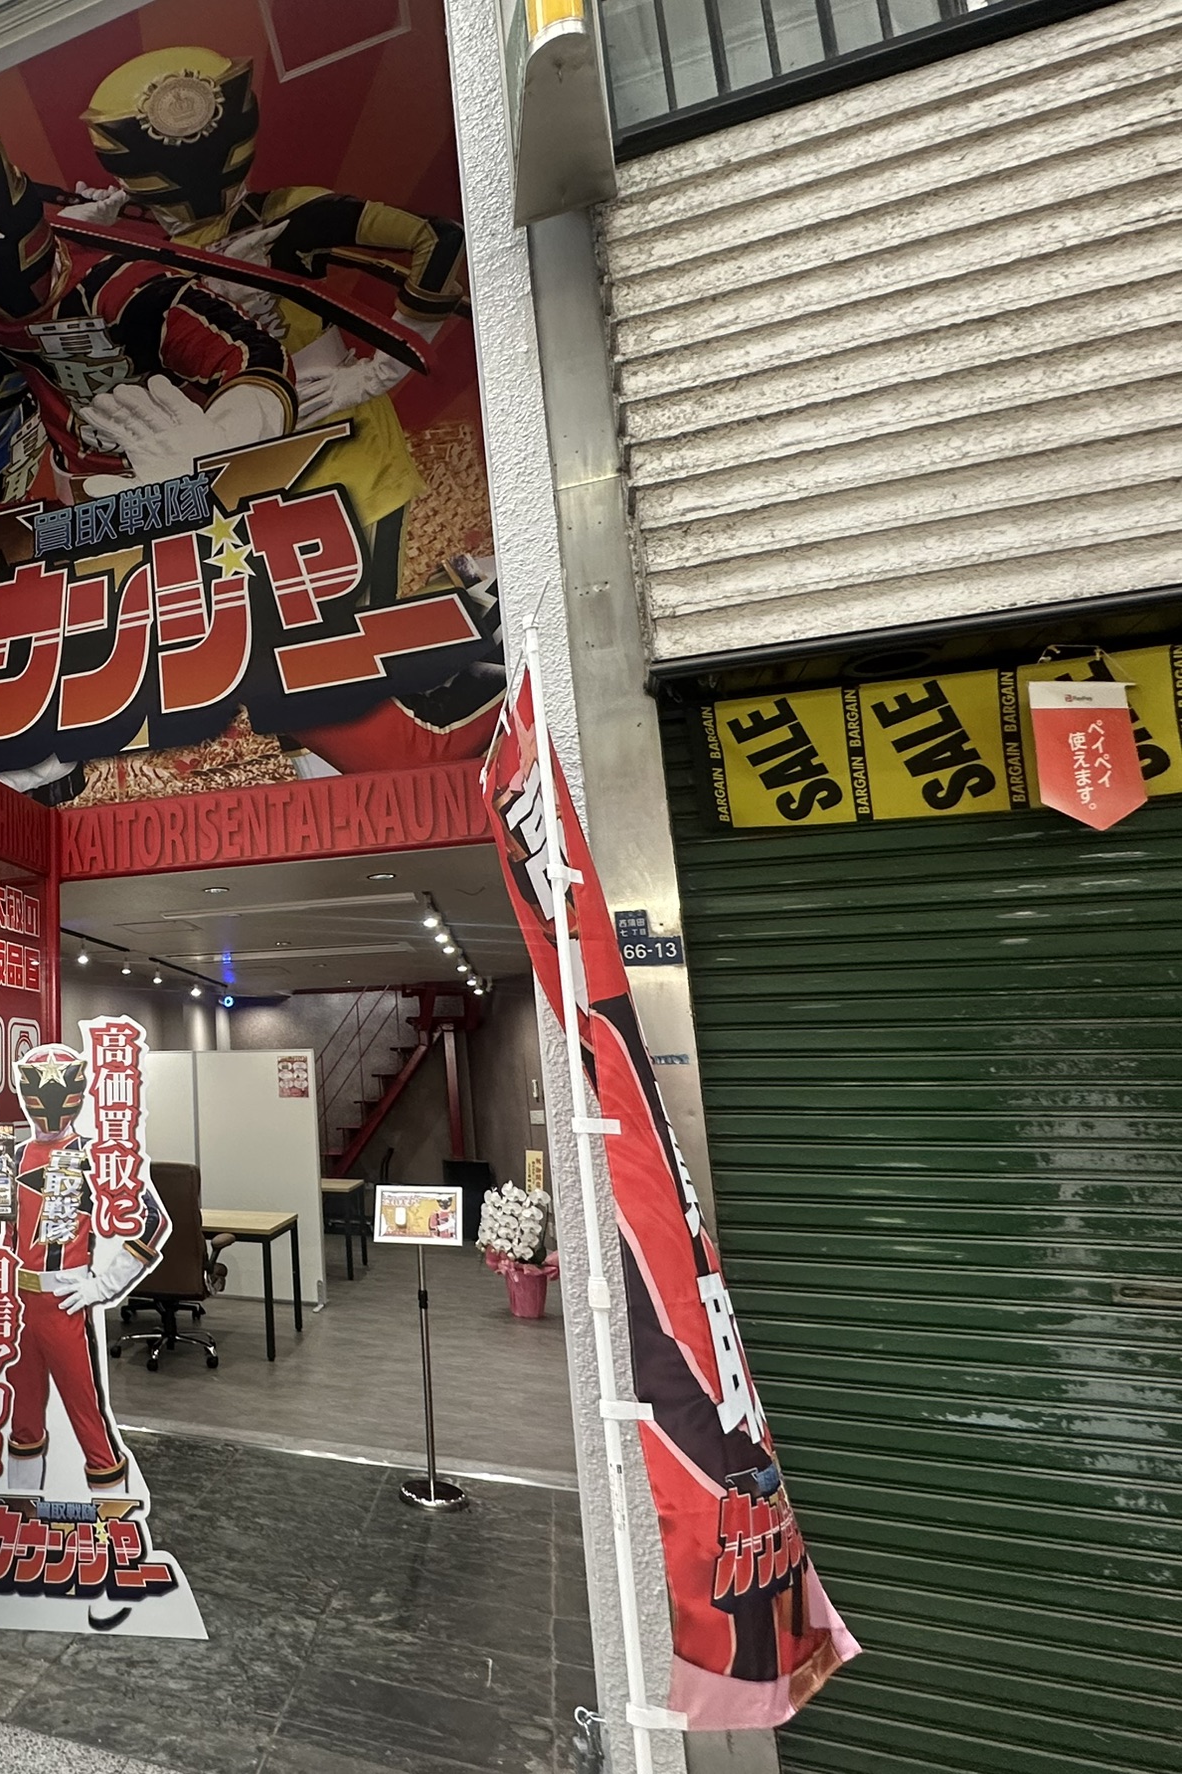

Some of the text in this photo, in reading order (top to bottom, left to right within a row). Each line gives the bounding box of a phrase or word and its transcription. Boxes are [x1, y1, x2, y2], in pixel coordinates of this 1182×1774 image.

[33, 476, 212, 556] 買取戦隊
[701, 706, 723, 760] BARGAIN
[842, 689, 861, 749] BARGAIN
[1001, 671, 1017, 732] BARGAIN
[726, 697, 844, 822] SALE
[871, 679, 997, 811] SALE
[1006, 742, 1026, 803] BARGAIN
[1068, 731, 1098, 811] 使えます。
[1088, 719, 1113, 788] ペイペイ
[709, 766, 731, 824] BARGAIN
[851, 756, 871, 815] BARGAIN
[623, 942, 677, 960] 66-13
[92, 1025, 146, 1236] 高価買取に
[40, 1150, 85, 1244] 買取戦隊
